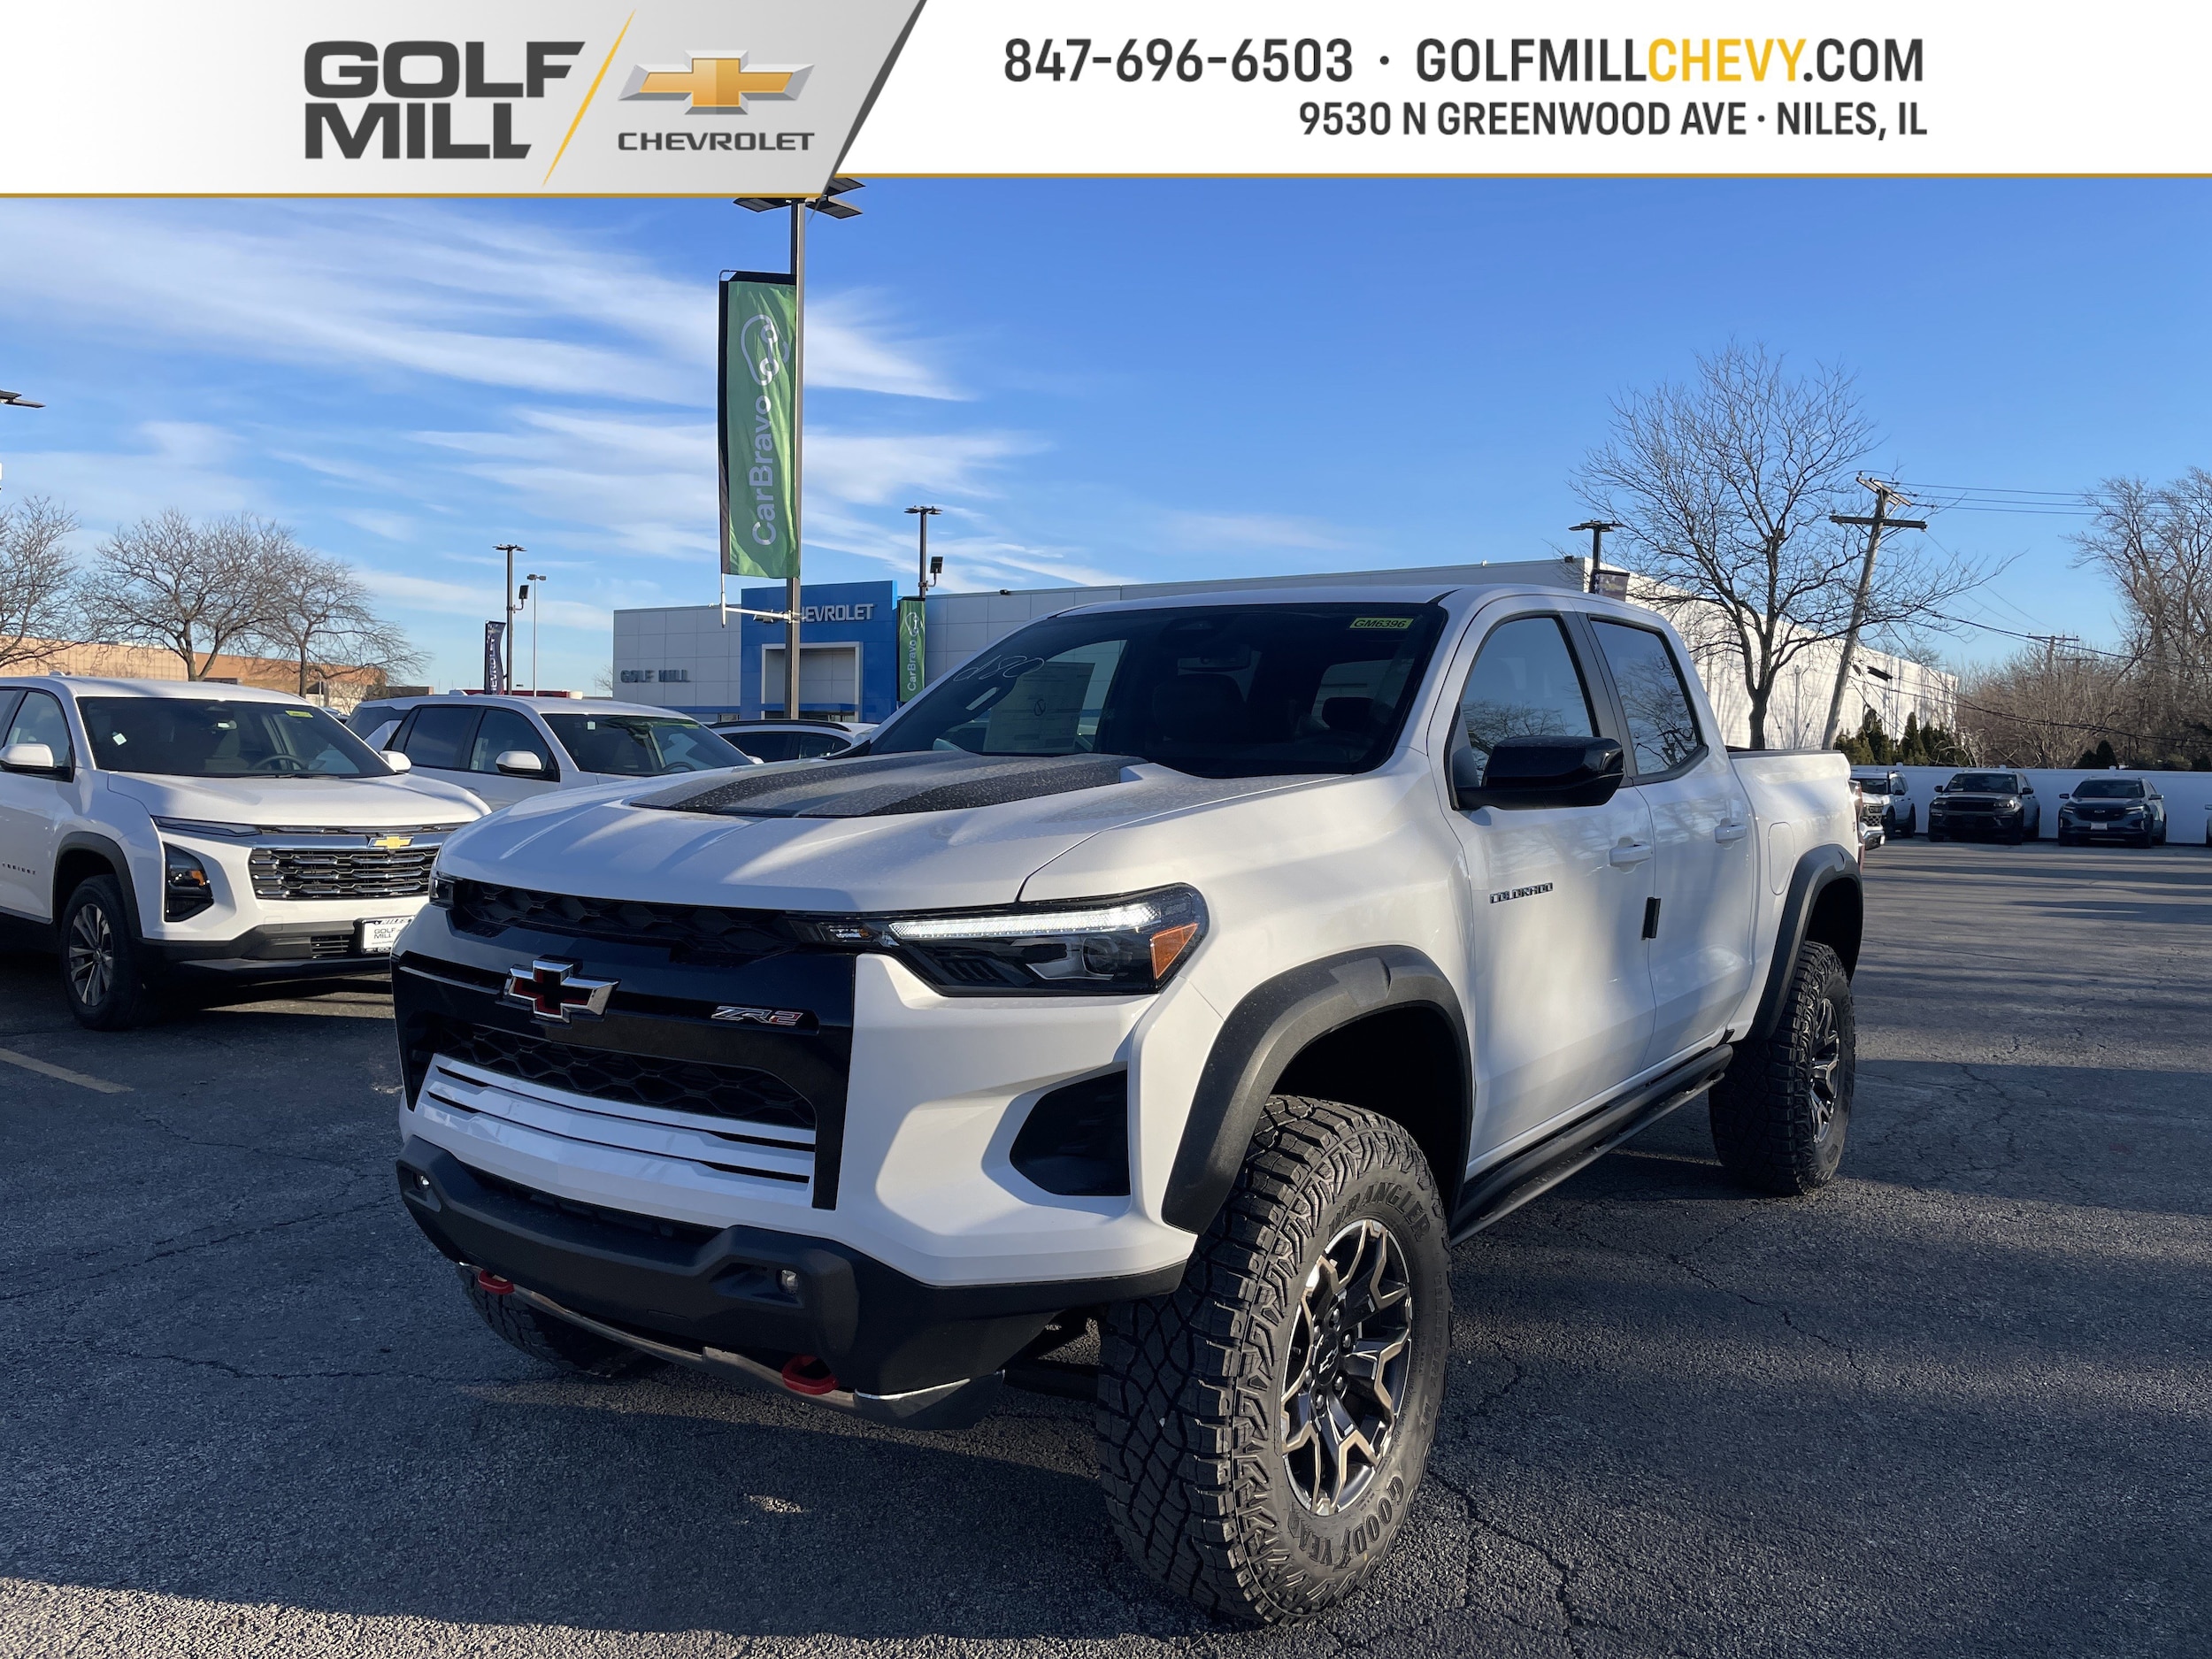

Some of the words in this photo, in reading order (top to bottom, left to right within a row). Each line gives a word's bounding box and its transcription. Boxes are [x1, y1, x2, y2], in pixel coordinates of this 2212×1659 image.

[749, 395, 777, 546] CarBravo
[1354, 619, 1407, 628] GM6396
[620, 670, 655, 683] GOLF
[907, 640, 918, 692] CarBravo
[1490, 882, 1554, 903] COLORADO
[710, 1006, 804, 1026] ZR2
[1327, 1181, 1431, 1241] WRANGLER
